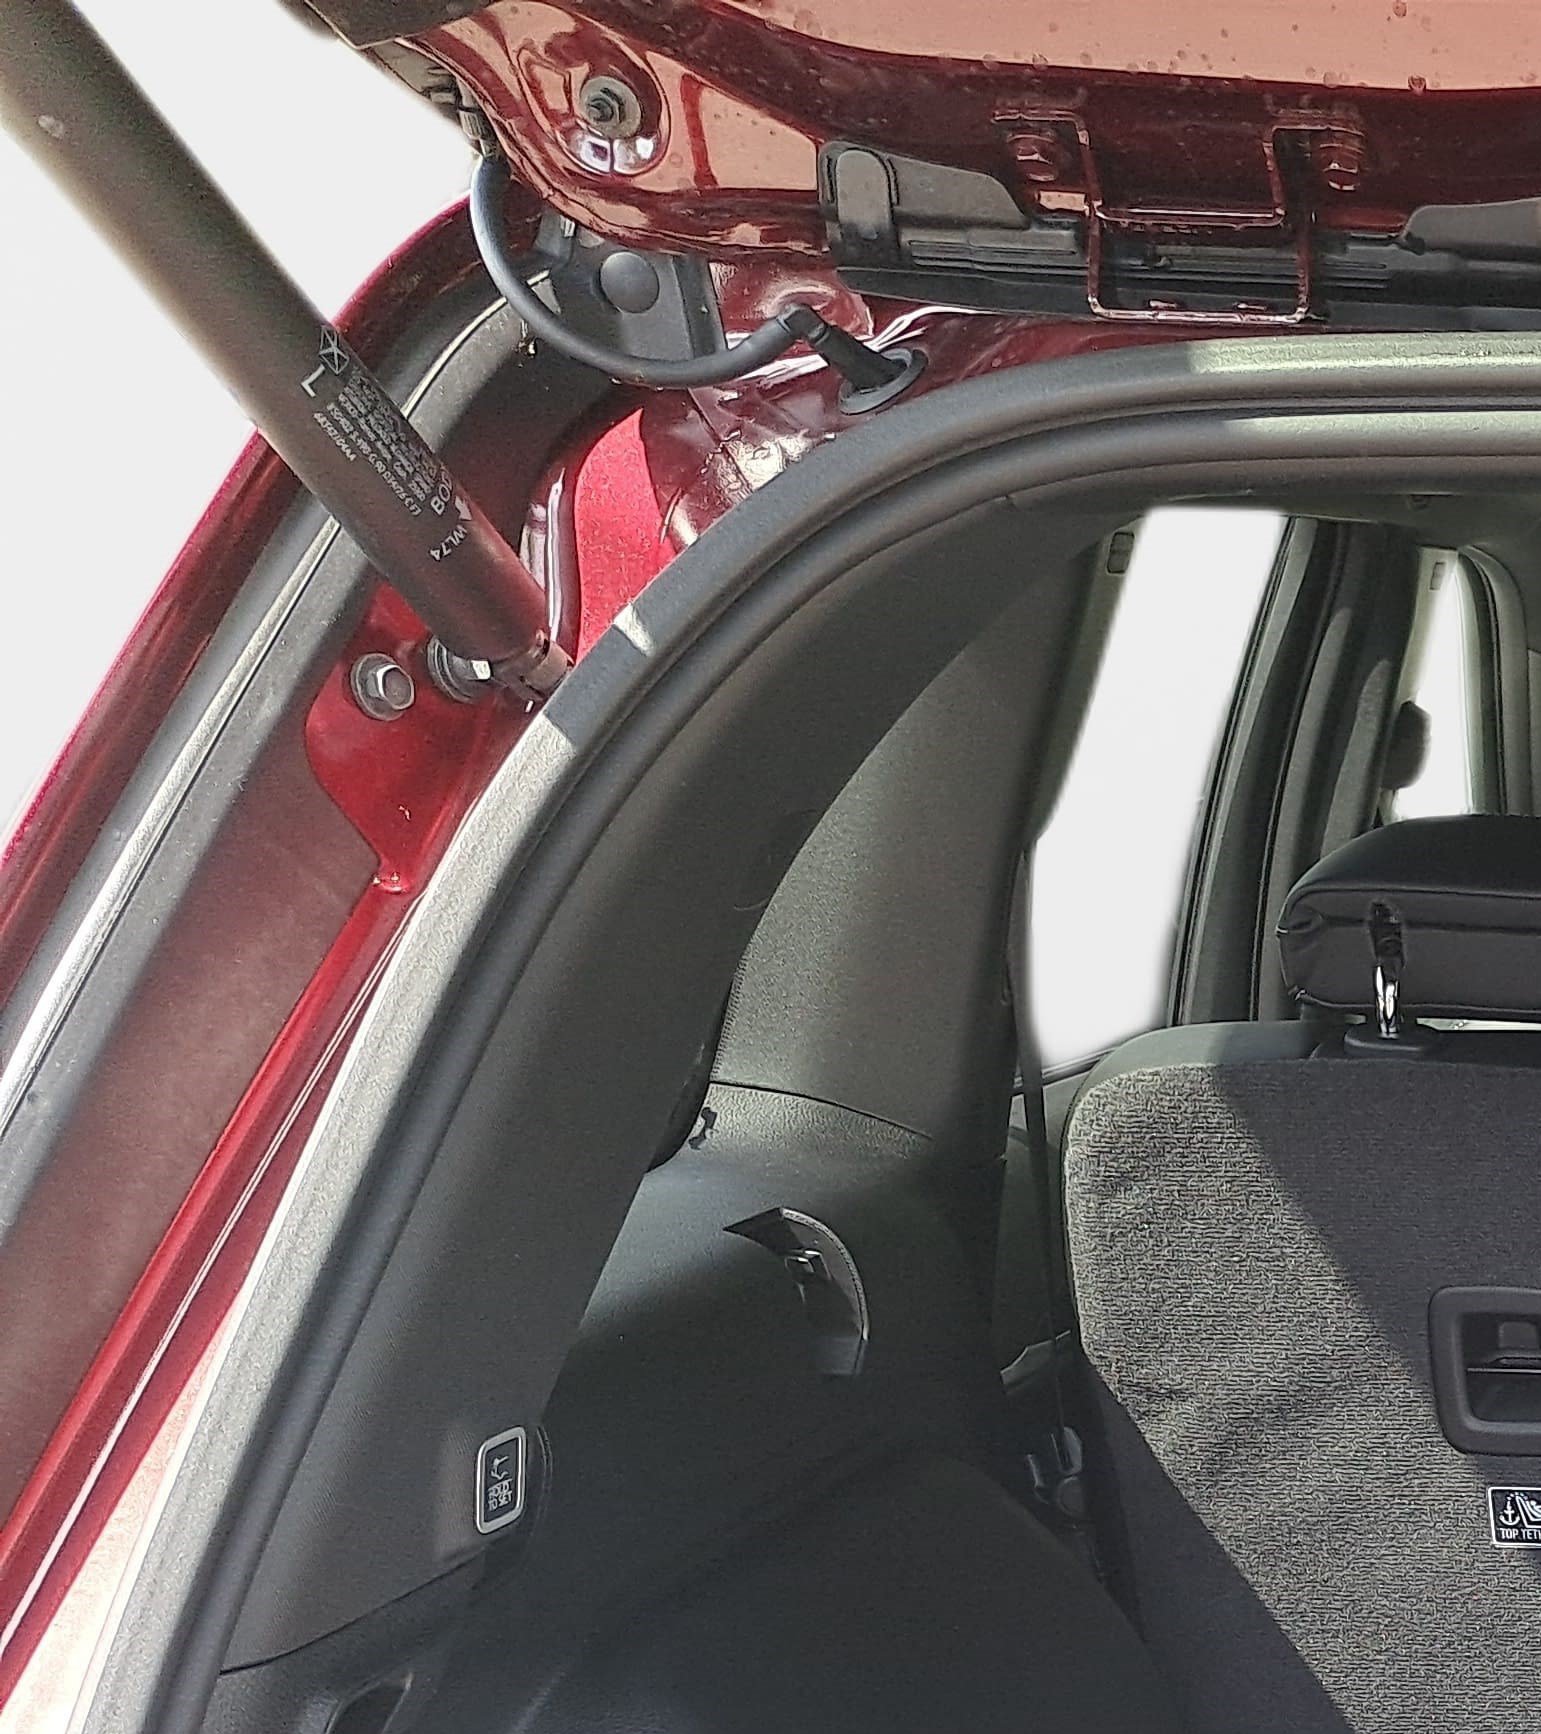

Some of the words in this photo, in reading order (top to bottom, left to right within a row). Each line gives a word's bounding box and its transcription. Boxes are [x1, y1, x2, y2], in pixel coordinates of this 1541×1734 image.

[301, 365, 325, 397] L
[430, 524, 468, 562] WL74
[487, 1478, 513, 1500] HOLD
[488, 1498, 498, 1511] TO
[498, 1491, 513, 1507] SET
[1499, 1528, 1519, 1539] TOP
